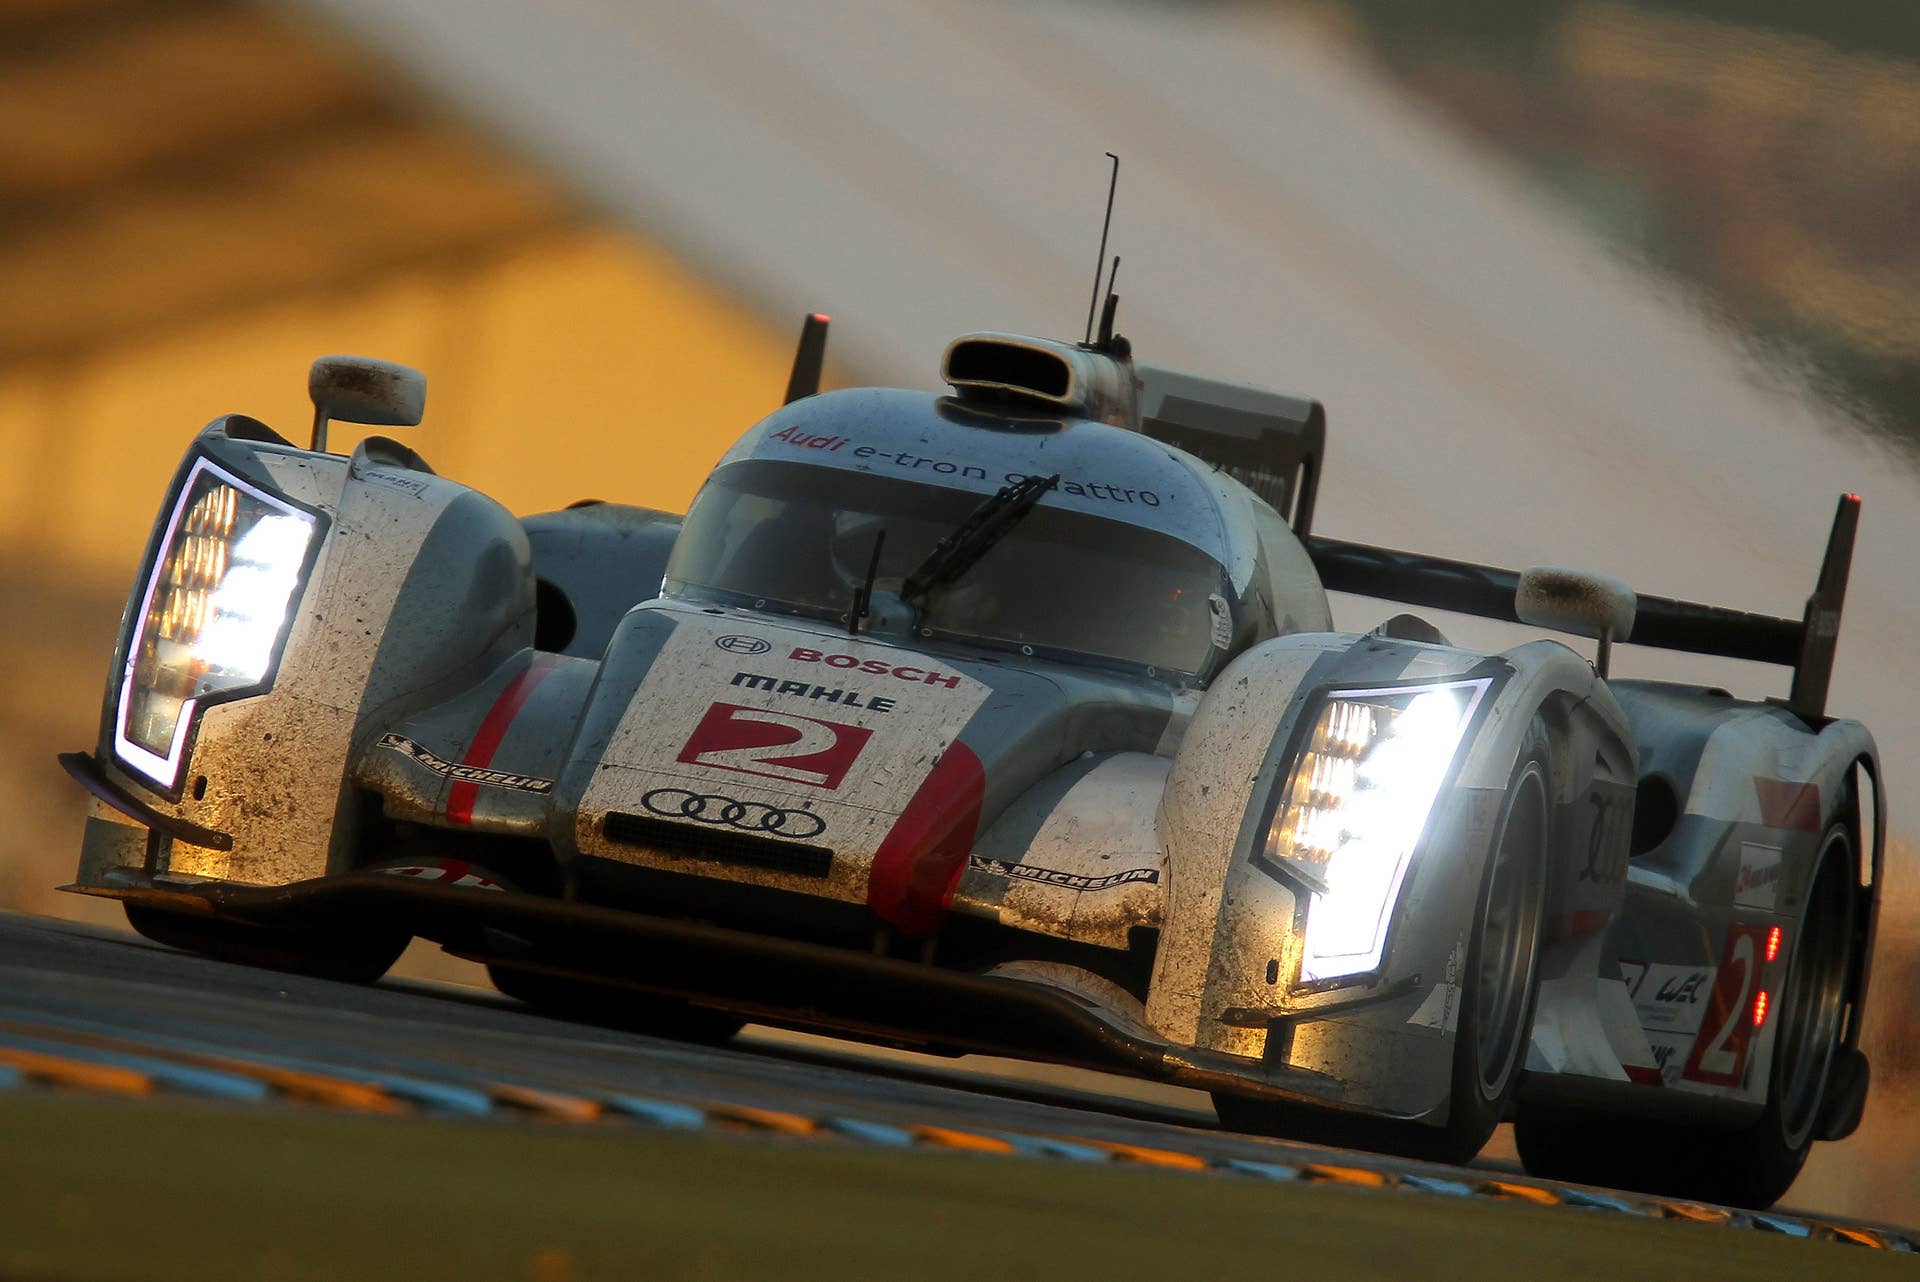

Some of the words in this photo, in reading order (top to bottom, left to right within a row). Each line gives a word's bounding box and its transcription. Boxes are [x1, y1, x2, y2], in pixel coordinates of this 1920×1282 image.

[770, 425, 845, 453] Audi
[853, 444, 987, 480] e-tron
[1004, 473, 1160, 507] qattro
[788, 647, 961, 690] BOSCH
[730, 672, 896, 713] MAHLE
[695, 710, 837, 785] 2
[417, 753, 552, 790] MICHELIN
[1010, 864, 1153, 889] MICHELIN
[1698, 934, 1754, 1074] 2
